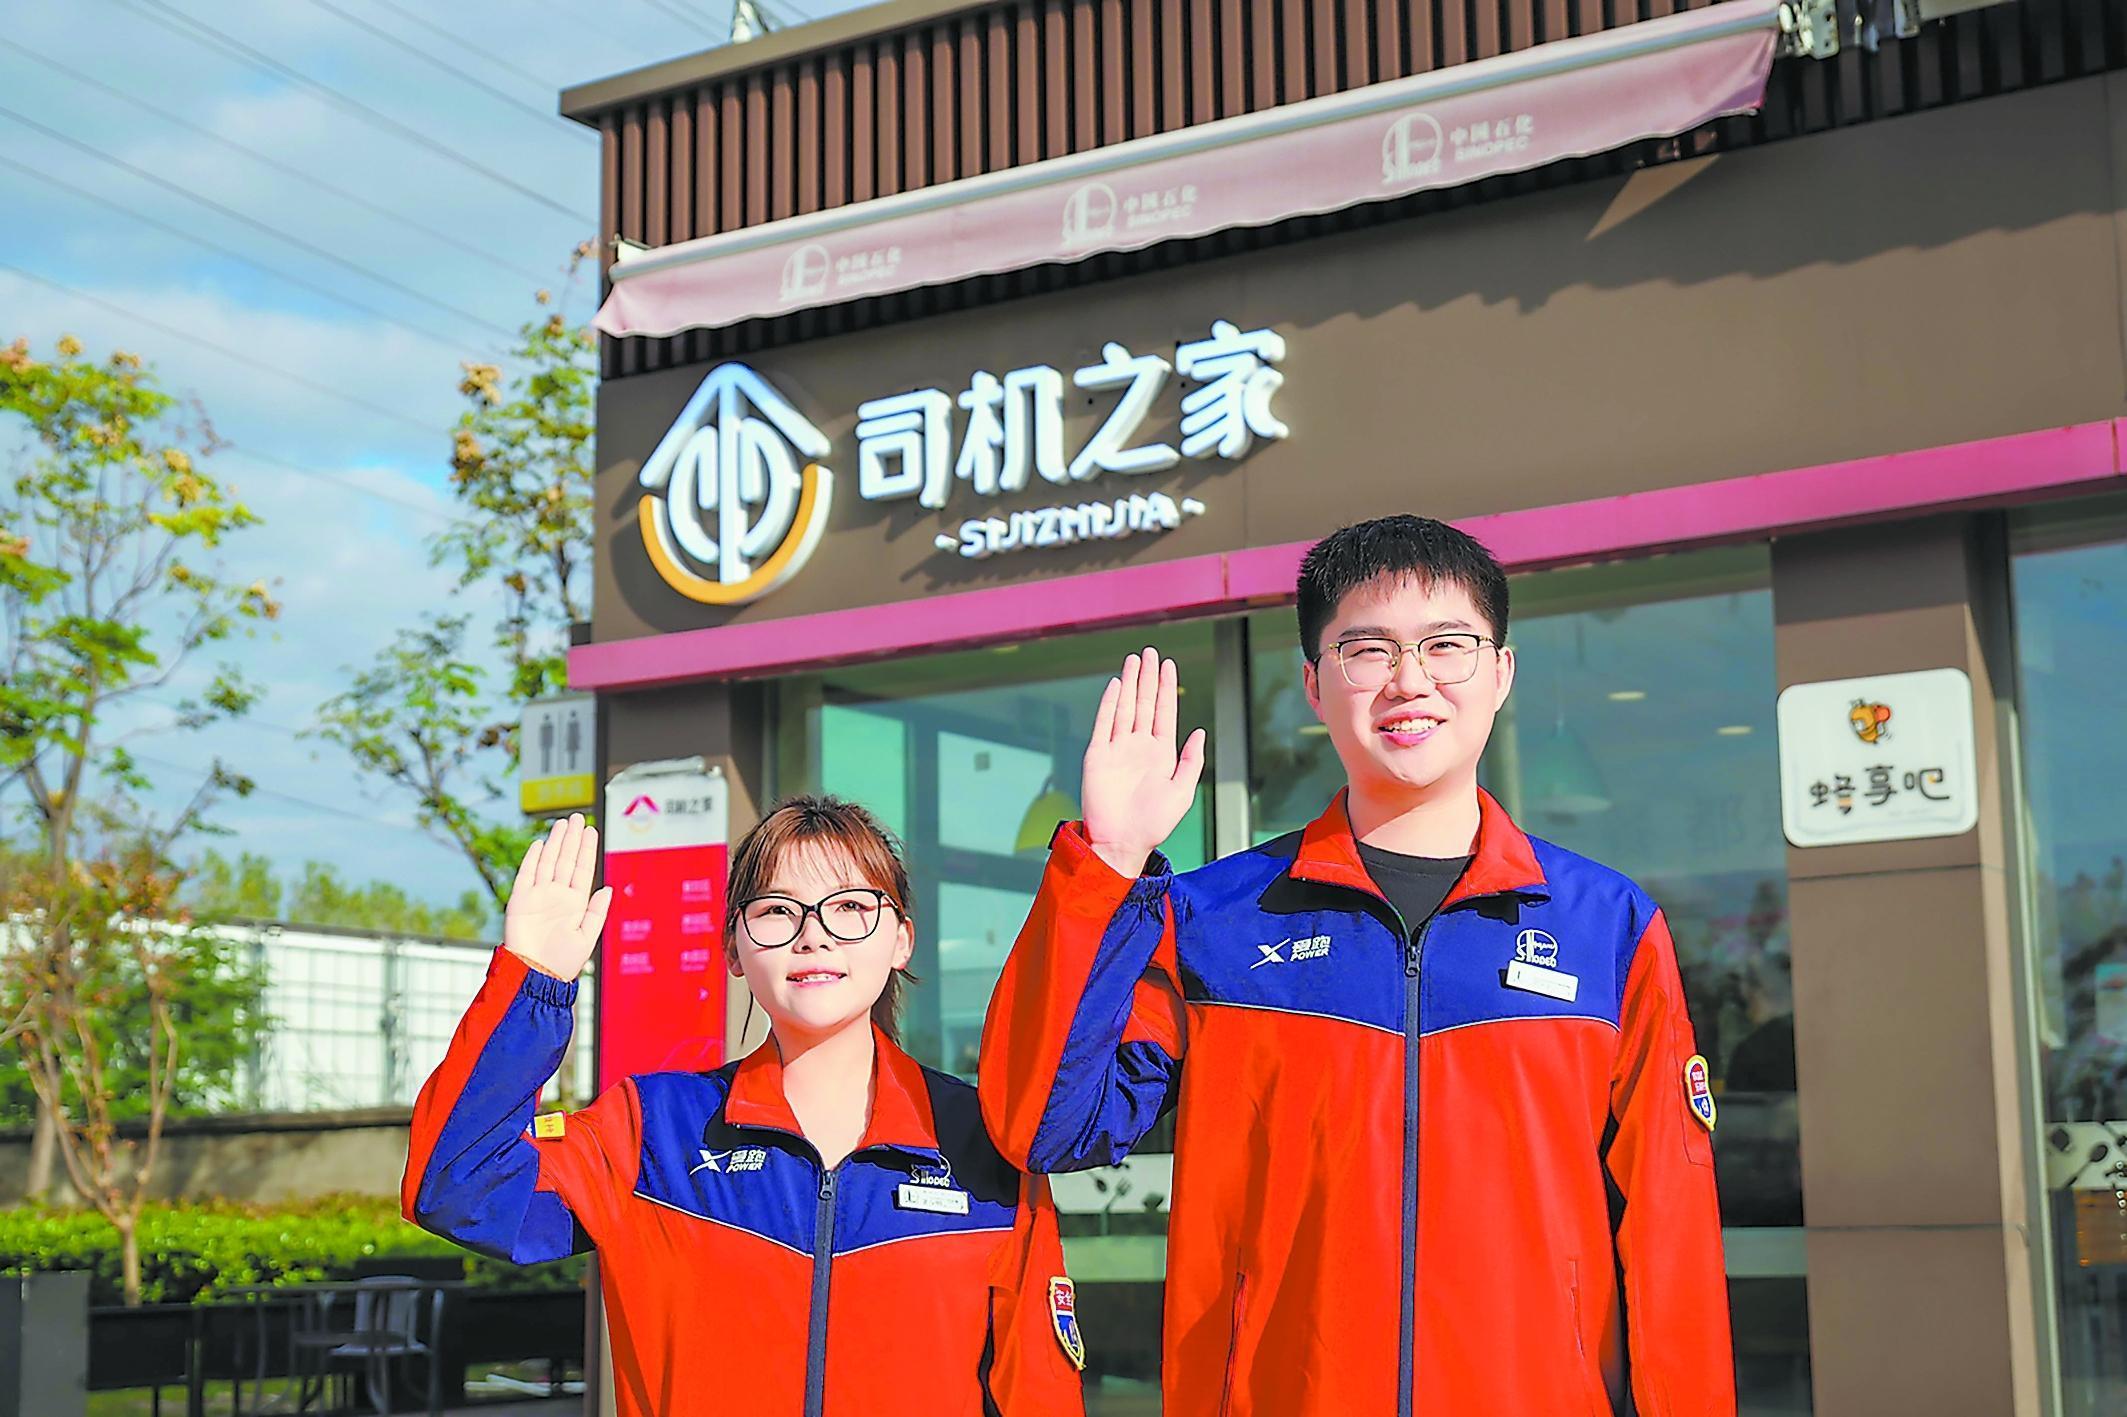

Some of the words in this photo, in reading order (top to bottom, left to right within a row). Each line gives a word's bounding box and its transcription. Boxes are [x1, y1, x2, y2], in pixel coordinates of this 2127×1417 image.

[855, 320, 1289, 508] 司机之家
[1290, 948, 1329, 962] POWER
[725, 1162, 763, 1174] POWER
